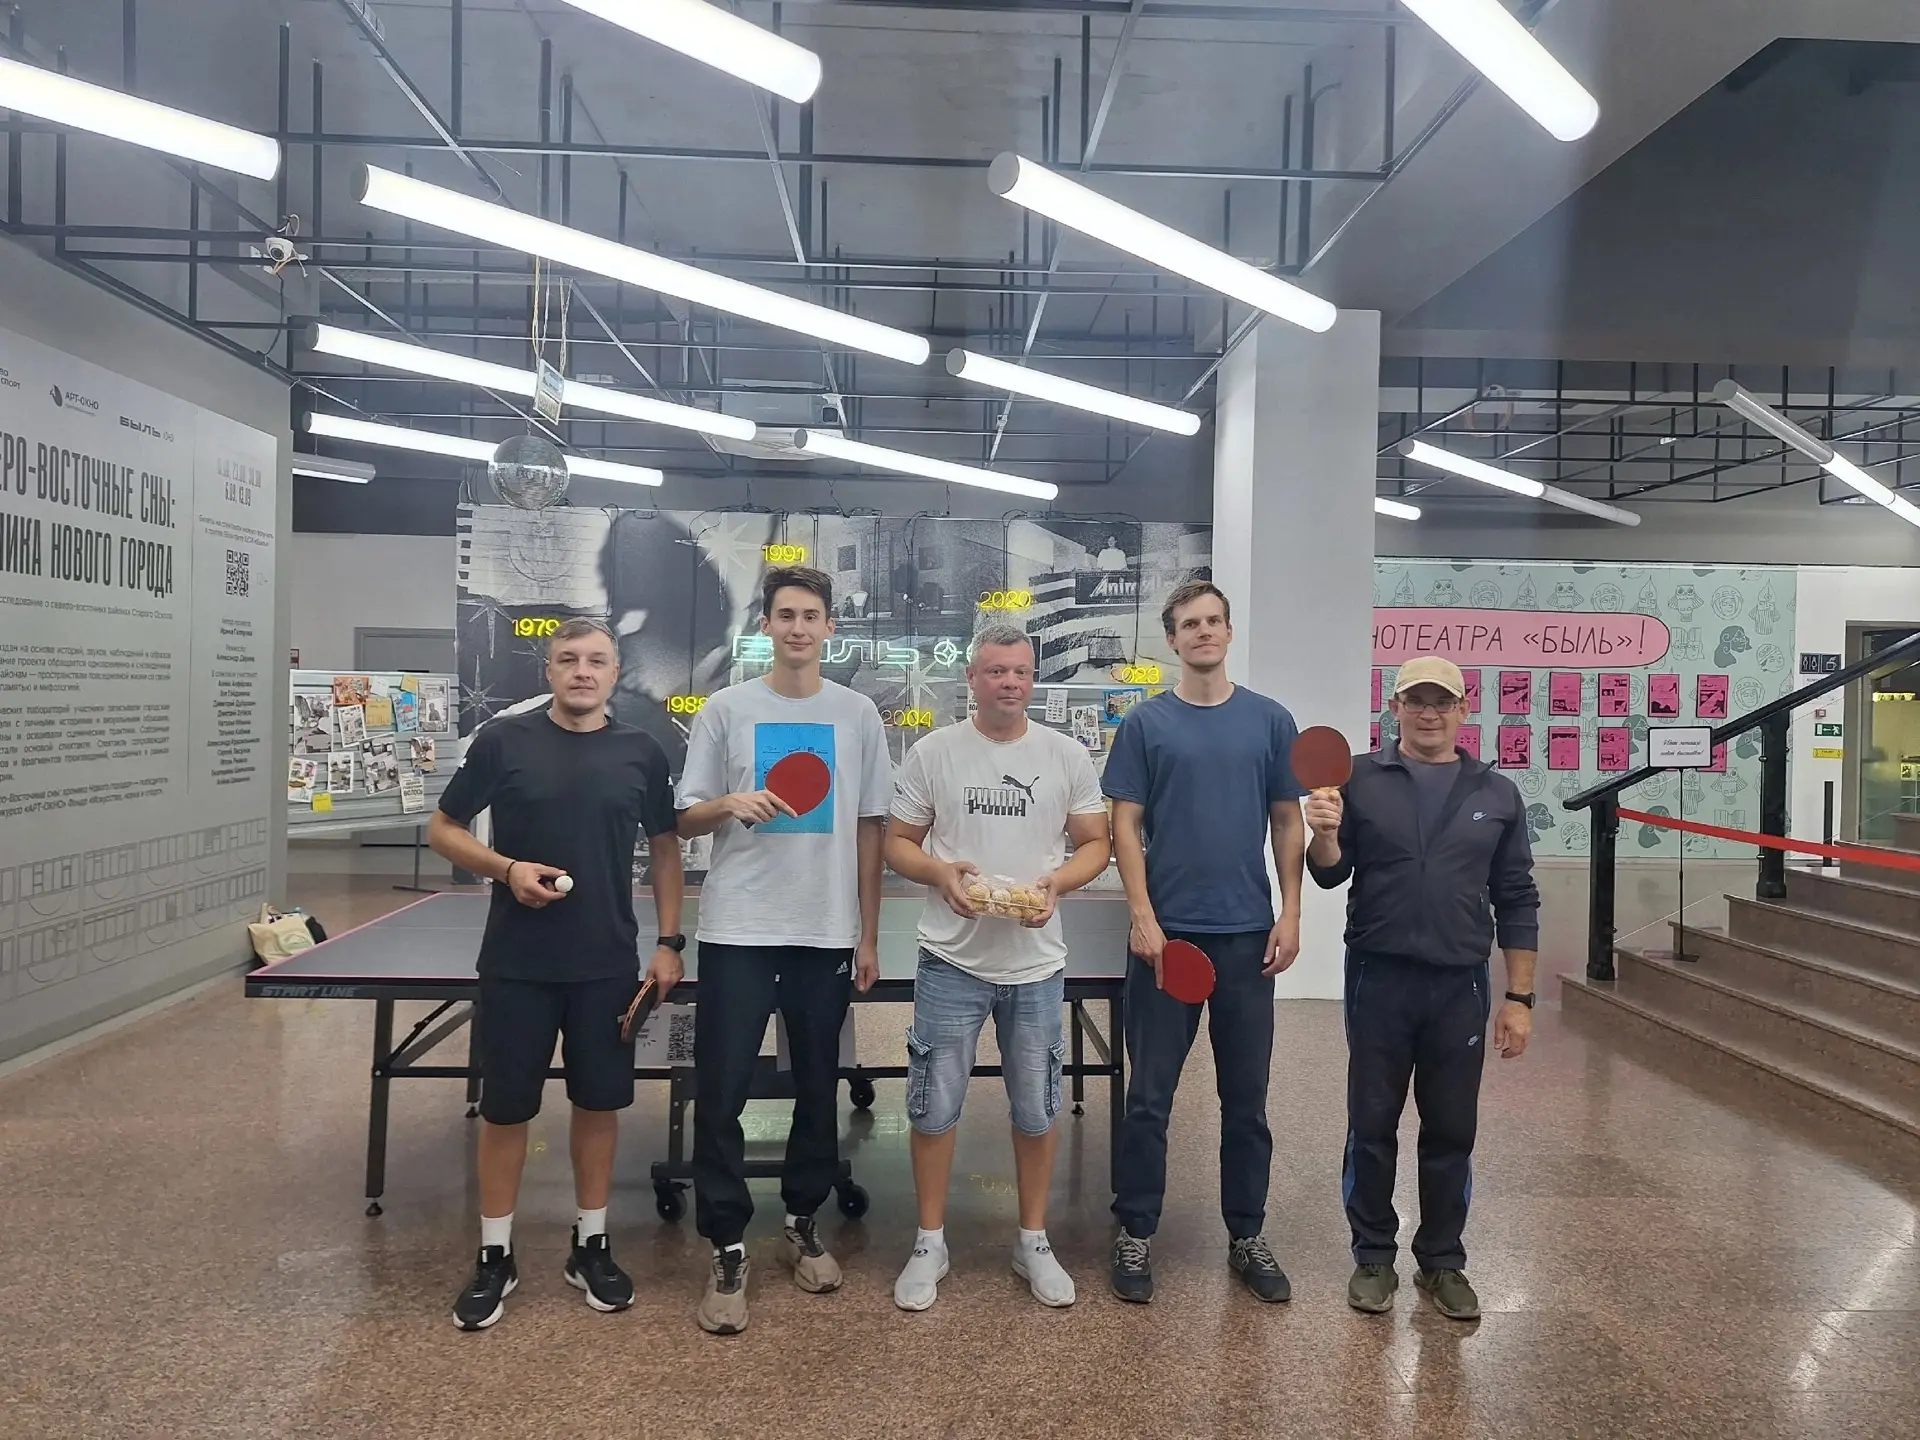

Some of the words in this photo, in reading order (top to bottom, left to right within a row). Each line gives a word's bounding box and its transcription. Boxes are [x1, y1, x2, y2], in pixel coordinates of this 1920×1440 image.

[119, 415, 161, 438] БЫЛЬ
[140, 472, 176, 529] СНЫ:
[50, 523, 112, 586] НОВОГО
[119, 536, 173, 598] ГОРОДА
[762, 544, 805, 564] 1991
[979, 590, 1032, 610] 2020
[511, 617, 559, 637] 1979
[880, 709, 932, 728] 2004
[964, 787, 1020, 807] PUMA
[260, 986, 319, 997] START
[320, 986, 357, 997] LINE
